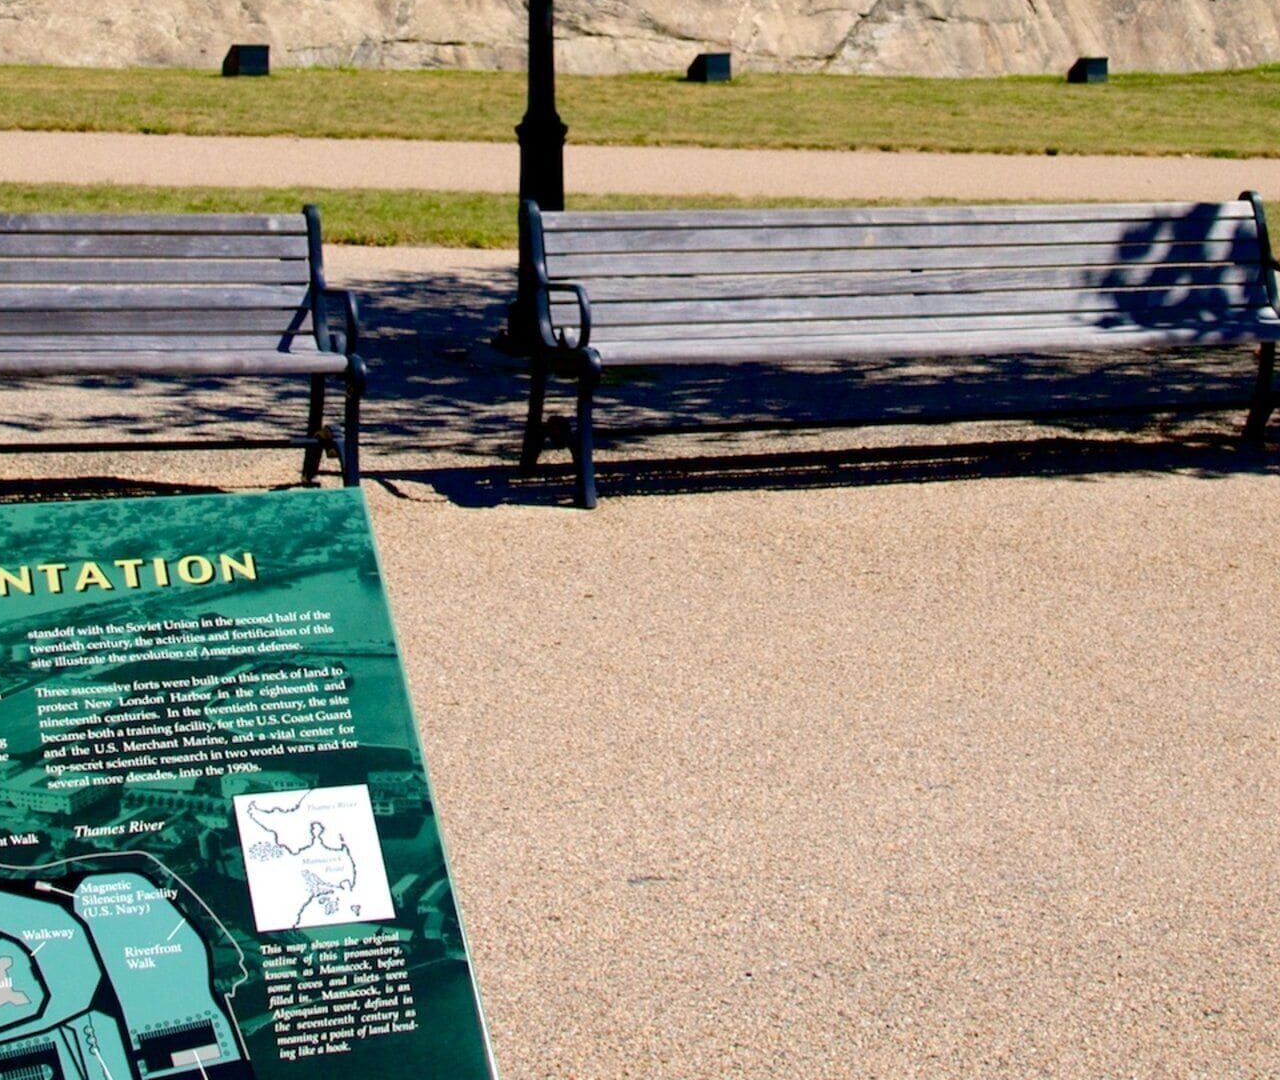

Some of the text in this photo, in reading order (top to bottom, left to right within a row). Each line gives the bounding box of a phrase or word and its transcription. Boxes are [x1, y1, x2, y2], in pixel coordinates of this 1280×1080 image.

[28, 609, 330, 638] standoff with the Soviet Union in the second half of the
[30, 623, 334, 652] twentieth century, the activities and fortification of this
[31, 641, 303, 667] site illustrate the evolution of American defense.
[35, 665, 343, 697] Three successive forts were built on this neck of land to
[38, 680, 345, 714] protect New London Harbor in the eighteenth and
[74, 822, 165, 837] Thames River
[12, 833, 39, 845] Walk
[80, 879, 131, 893] Magnetic
[82, 888, 178, 904] Silencing Facility
[116, 901, 151, 914] Navy)
[22, 928, 74, 939] Walkway
[125, 941, 182, 956] Riverfront
[127, 956, 156, 968] Walk
